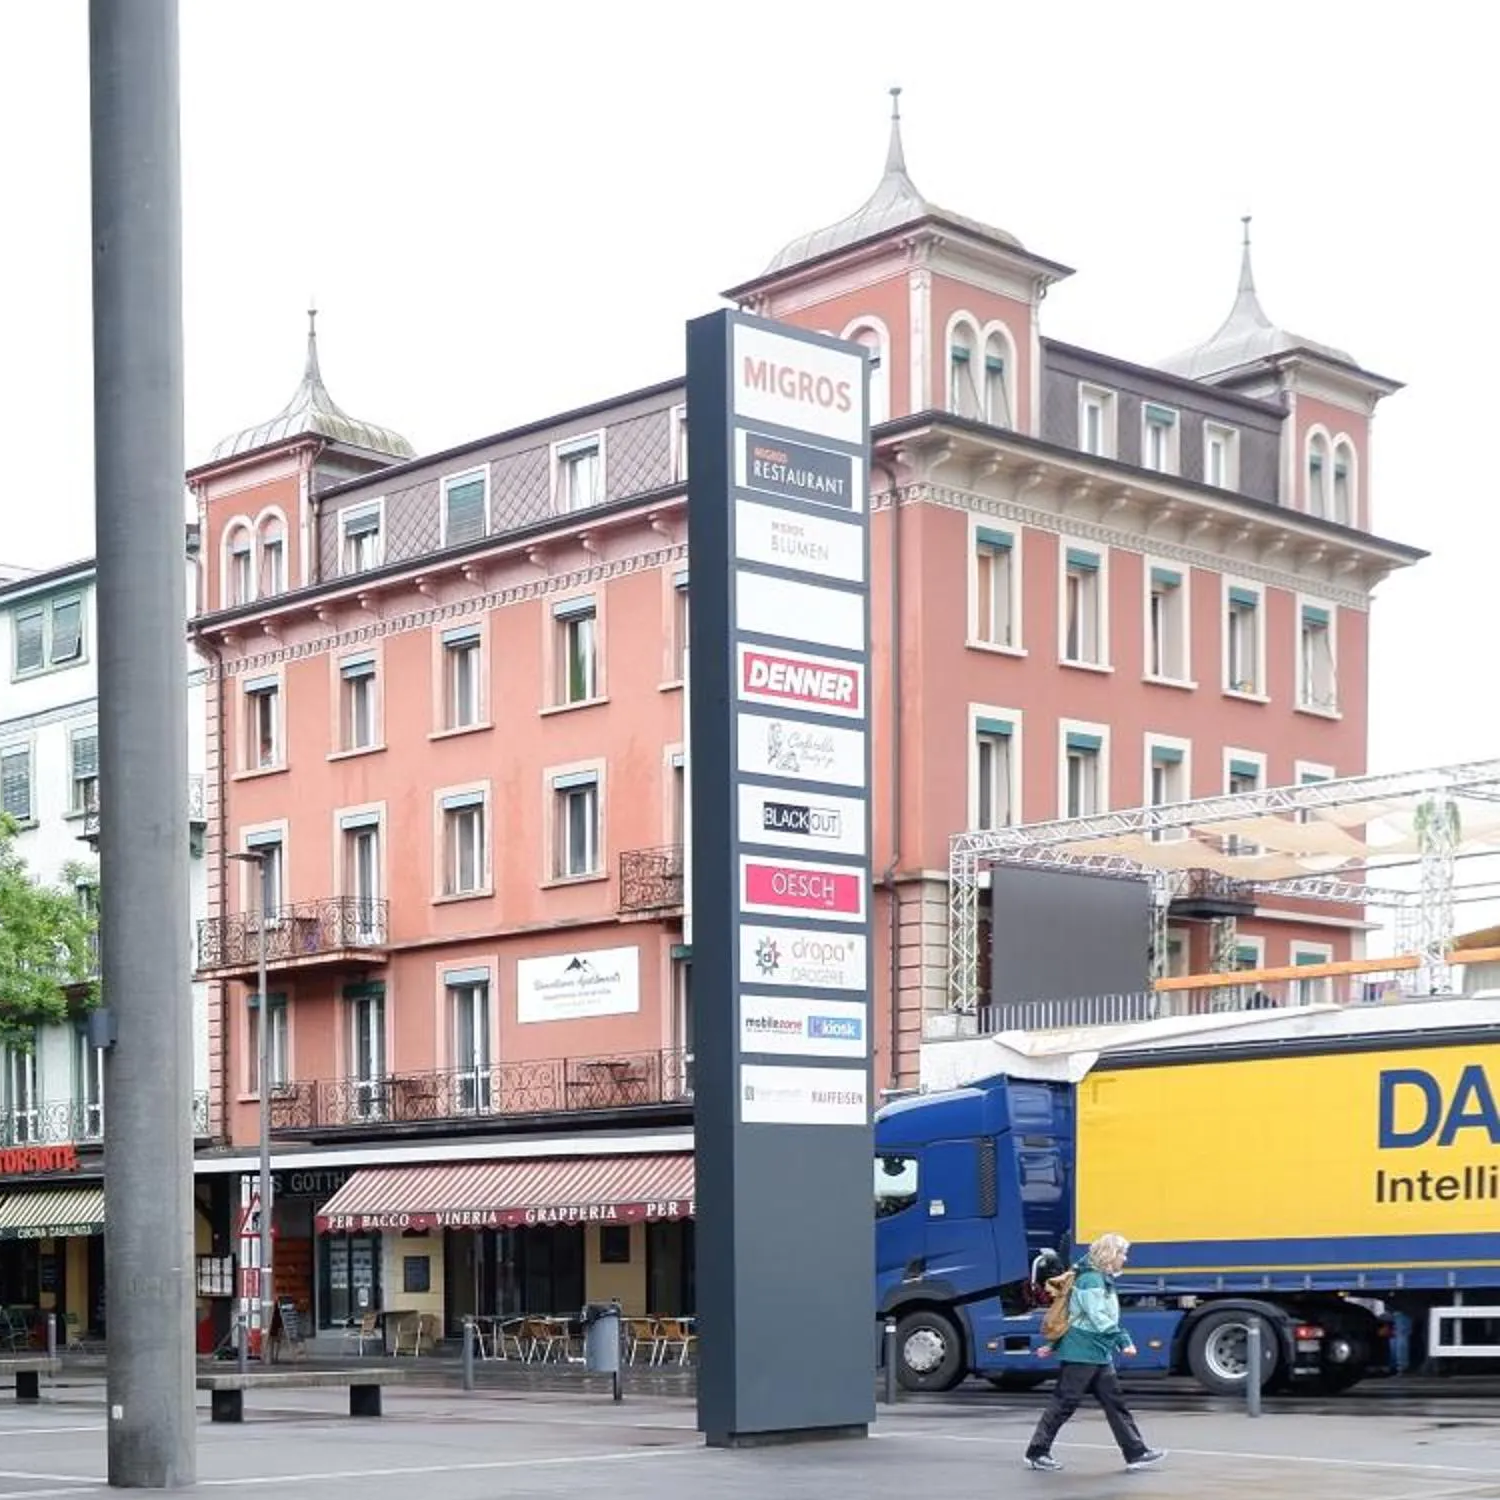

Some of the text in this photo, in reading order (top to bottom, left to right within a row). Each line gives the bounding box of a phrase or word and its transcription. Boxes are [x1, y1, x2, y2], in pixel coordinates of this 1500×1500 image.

[744, 356, 852, 413] MIGROS
[753, 459, 844, 495] RESTAURANT
[771, 534, 828, 561] BLUMEN
[749, 659, 853, 703] DENNER
[771, 872, 835, 900] OESCH
[792, 937, 845, 965] dropa
[745, 1016, 803, 1030] mobilezone
[811, 1091, 864, 1105] RAIFFEISEN
[1378, 1064, 1500, 1149] DA
[1376, 1166, 1498, 1203] Intelli
[328, 1214, 353, 1228] PER
[362, 1213, 409, 1227] BACCO
[436, 1211, 497, 1225] VINERIA
[525, 1205, 617, 1223] GRAPPERIA
[646, 1201, 678, 1217] PER
